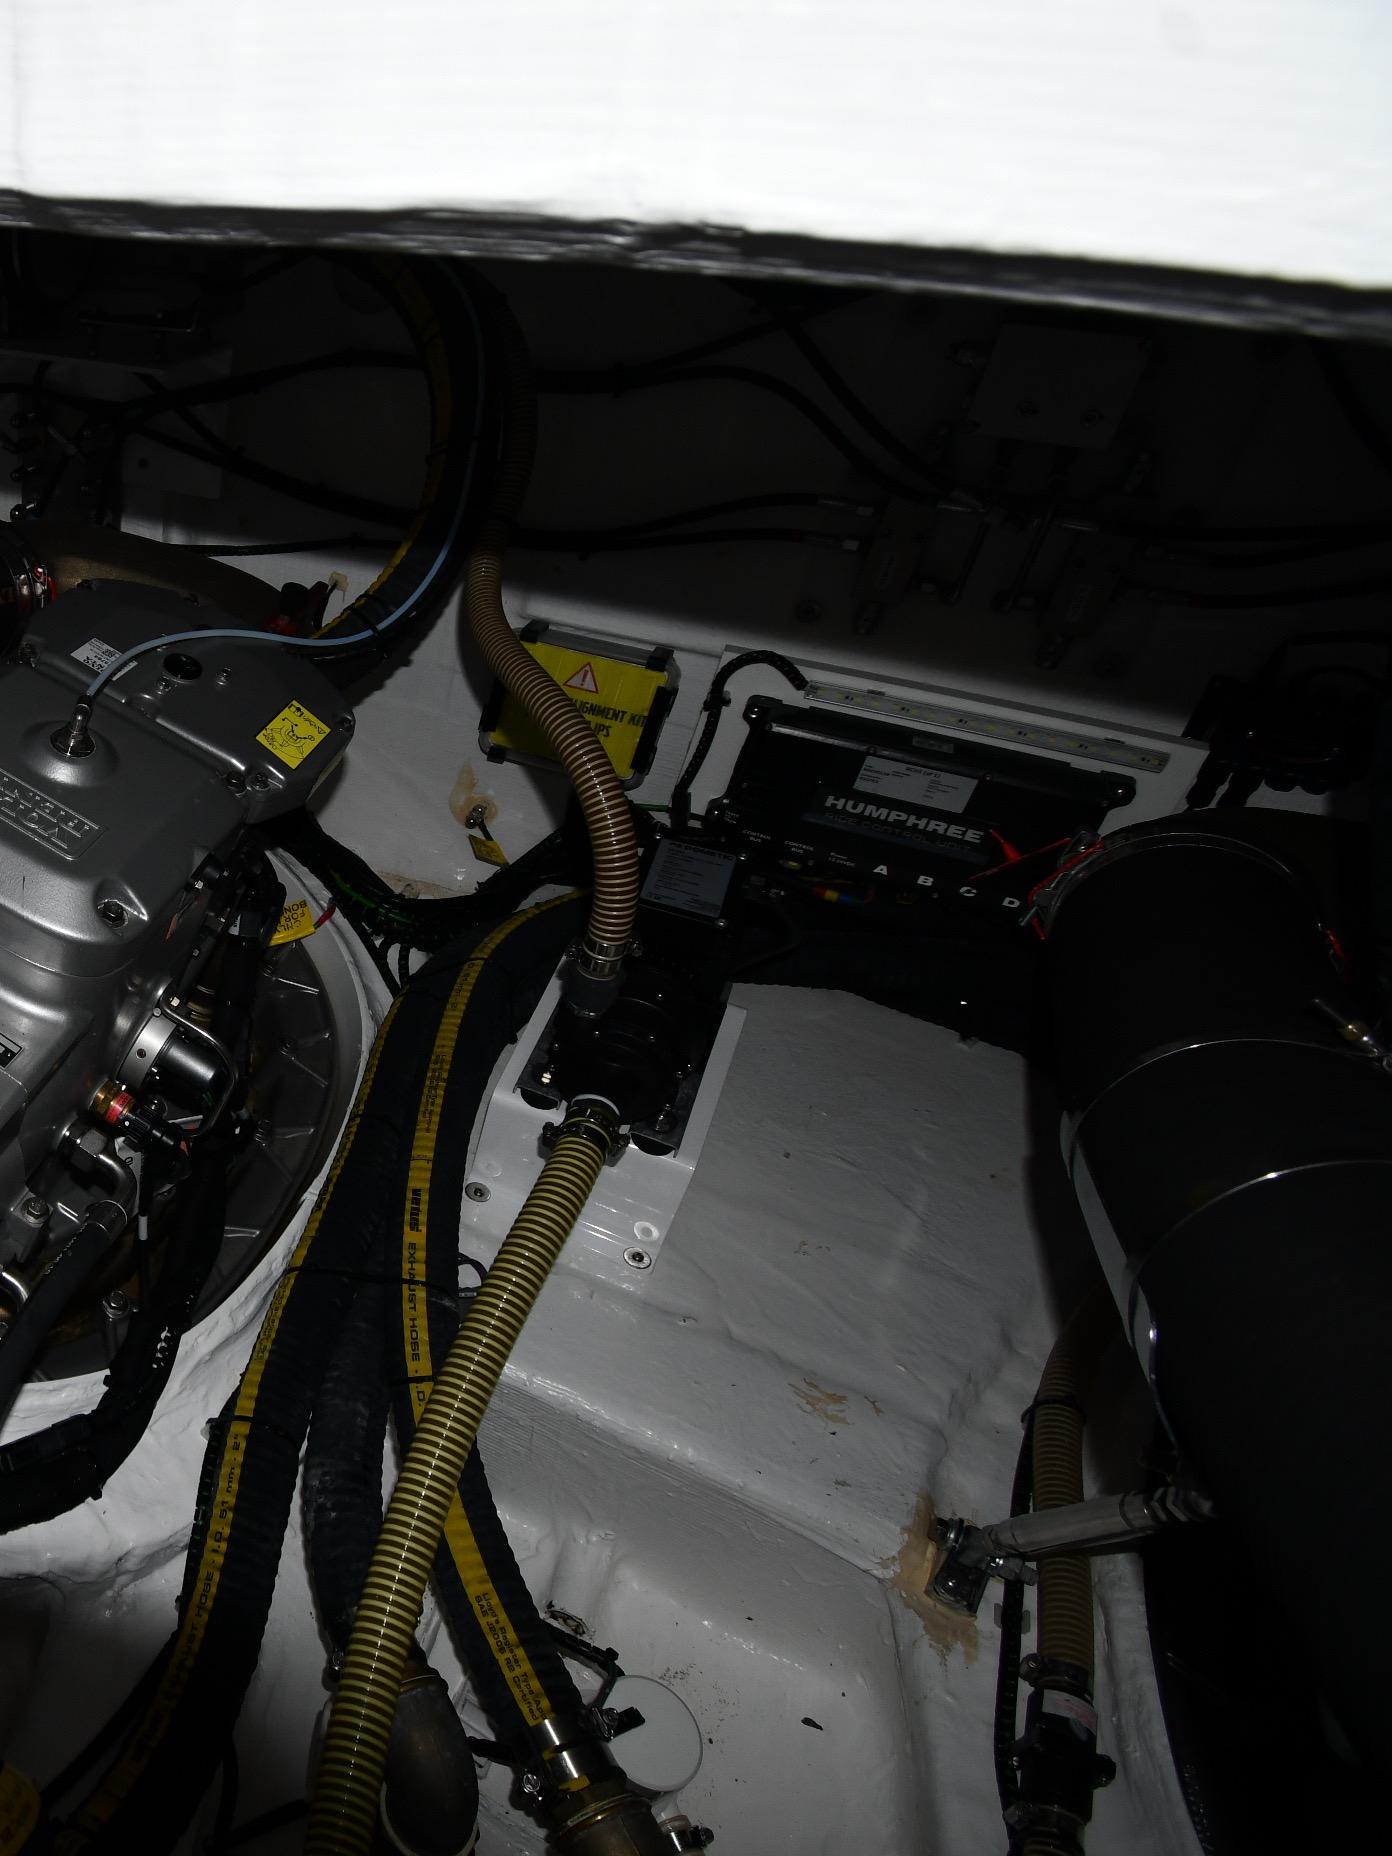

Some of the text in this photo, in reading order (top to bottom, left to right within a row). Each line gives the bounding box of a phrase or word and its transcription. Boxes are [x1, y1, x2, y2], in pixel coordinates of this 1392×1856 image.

[823, 794, 985, 844] HUMPHREE
[873, 864, 1020, 908] A B C D
[283, 910, 306, 923] FOR
[409, 1188, 422, 1232] vetus
[408, 1241, 417, 1313] EXHAUST
[409, 1317, 420, 1362] HOSE
[194, 1572, 214, 1618] HOSE
[226, 1467, 236, 1494] mm
[475, 1595, 488, 1618] SAE
[512, 1675, 539, 1721] Certified
[499, 1626, 522, 1670] Register
[522, 1671, 535, 1695] Type
